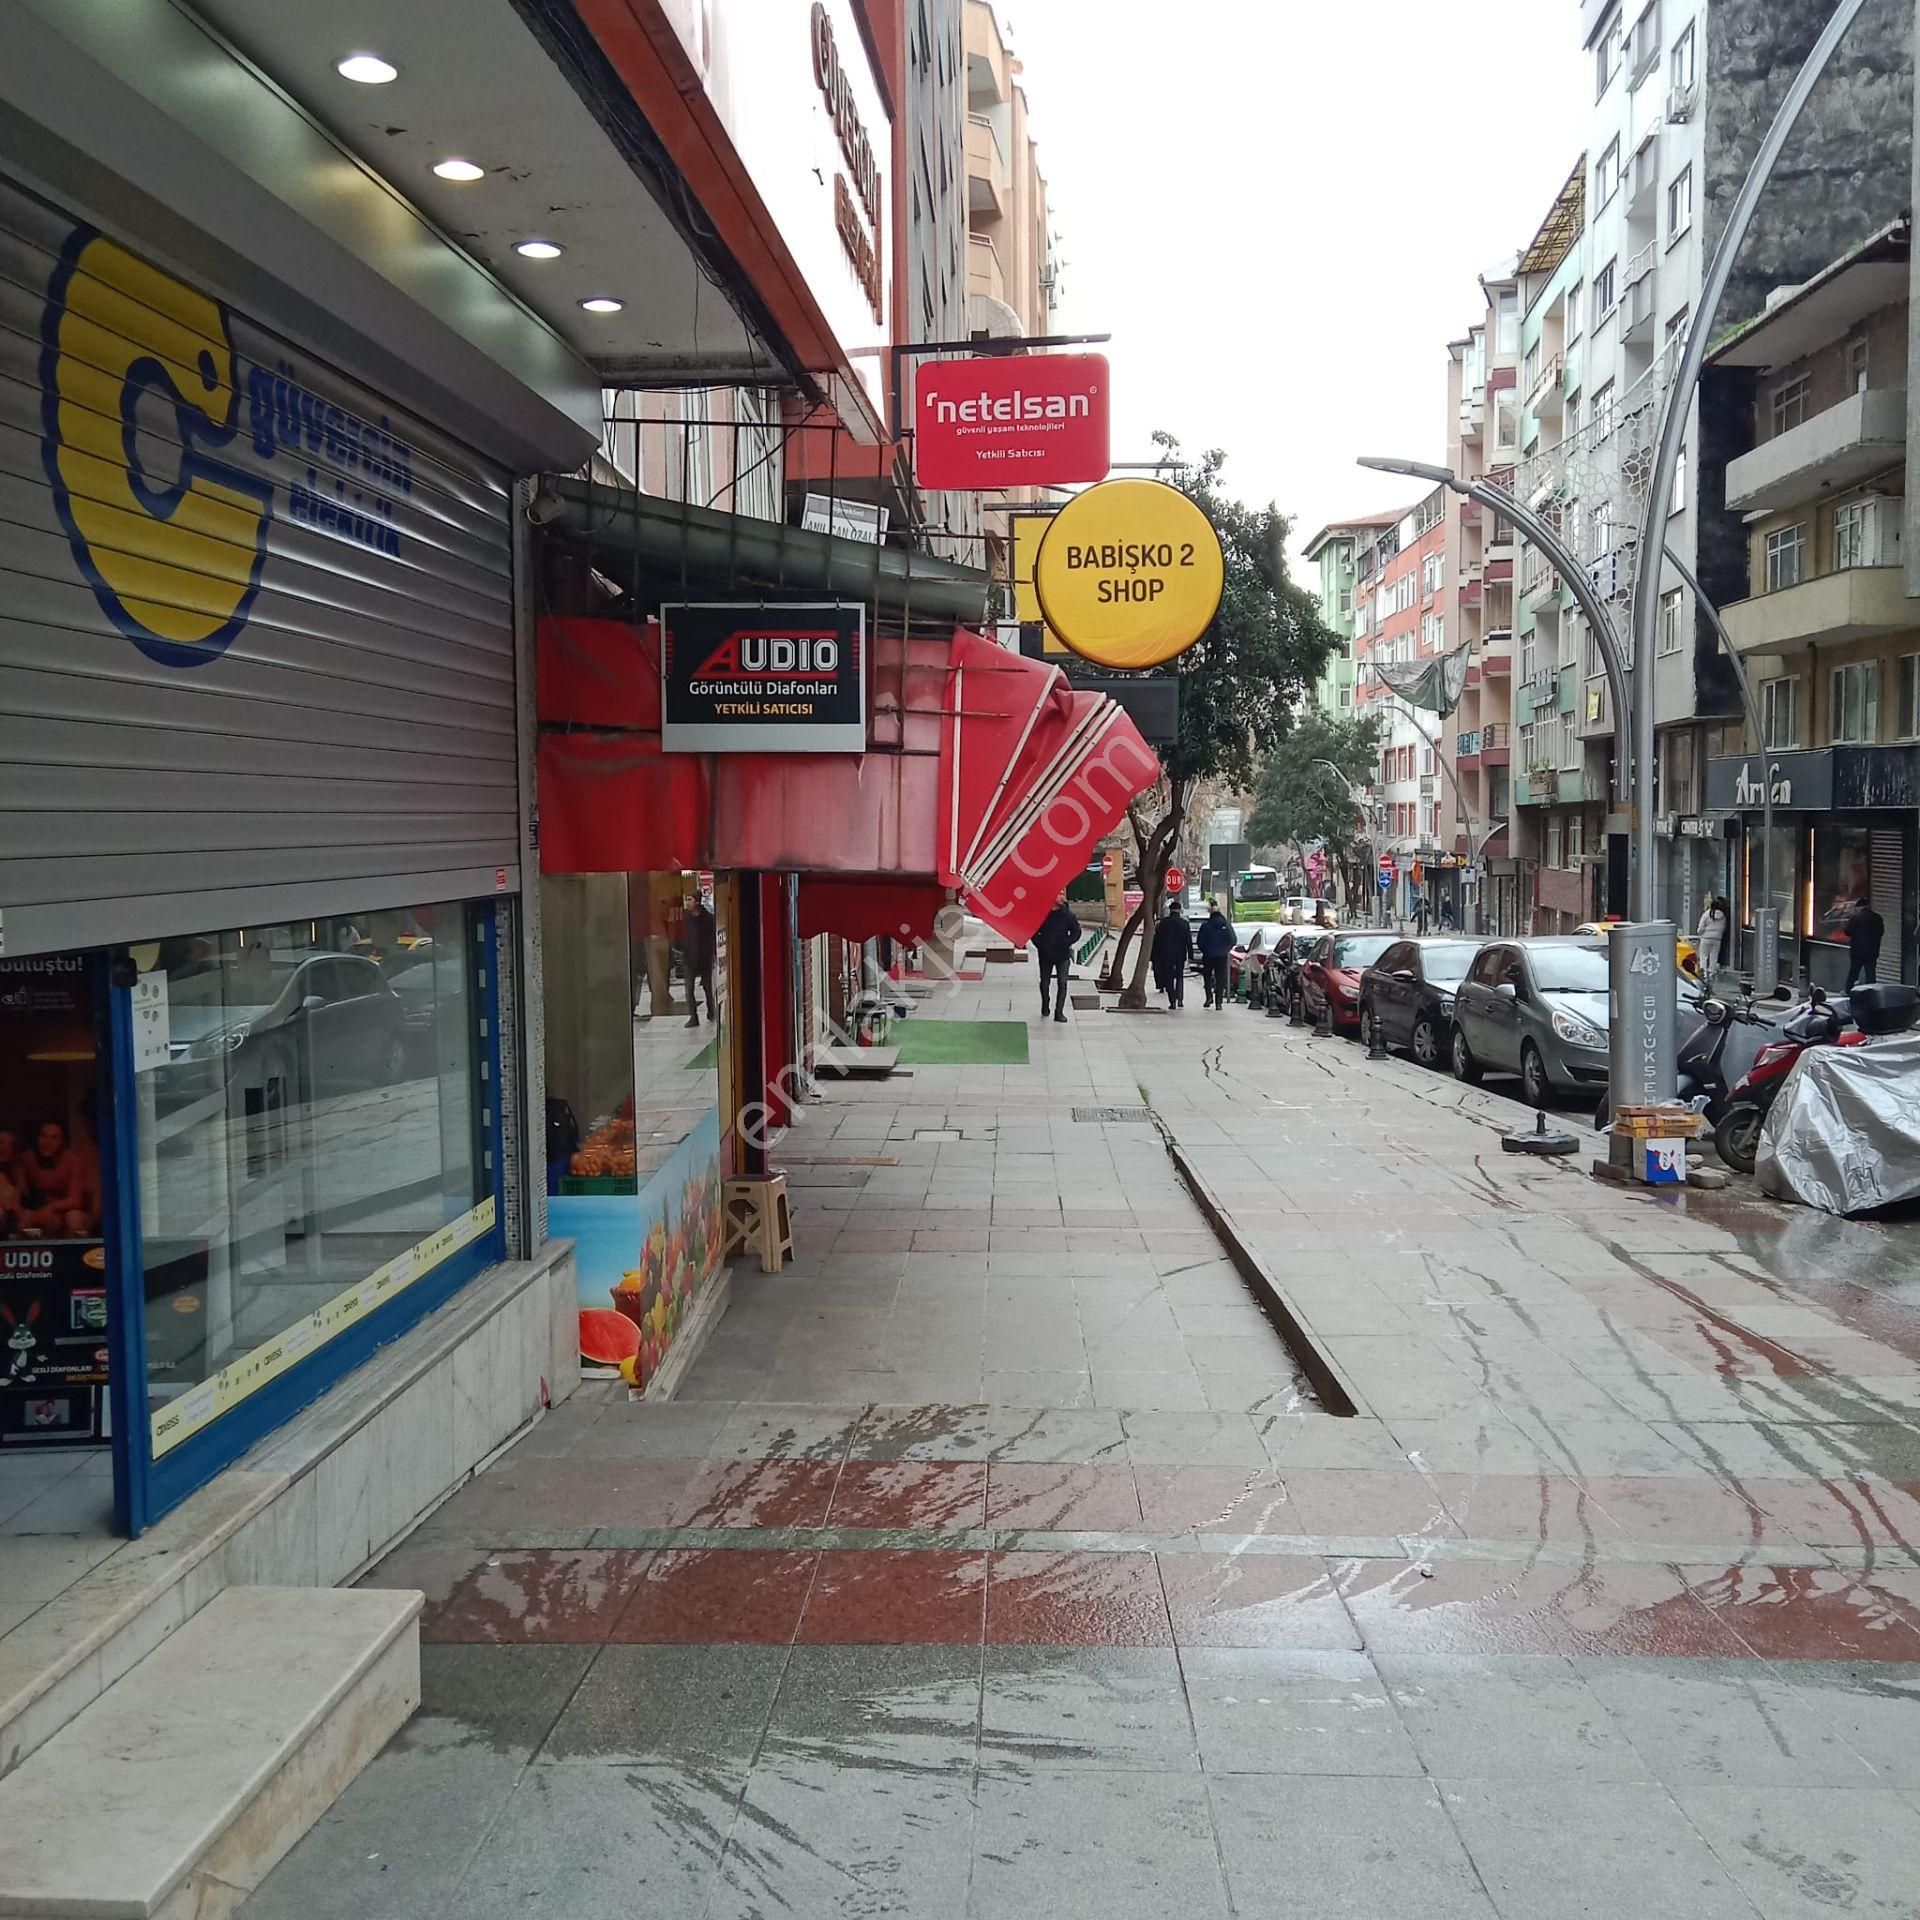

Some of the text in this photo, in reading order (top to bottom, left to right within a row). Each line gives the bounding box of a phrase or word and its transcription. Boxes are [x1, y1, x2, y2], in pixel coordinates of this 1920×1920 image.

[937, 390, 1089, 423] netelsan
[956, 422, 1065, 436] güvenli yaşam teknolojileri
[976, 448, 1046, 460] Yetkili Satıcısı
[1067, 539, 1195, 575] BABİŞKO 2
[1097, 578, 1165, 603] SHOP
[691, 630, 839, 680] AUDIO
[689, 680, 838, 696] Görüntülü Diafonları
[714, 701, 813, 715] YETKİLİ SATICISI
[1166, 875, 1182, 885] DUR
[2, 1250, 54, 1269] UDIO
